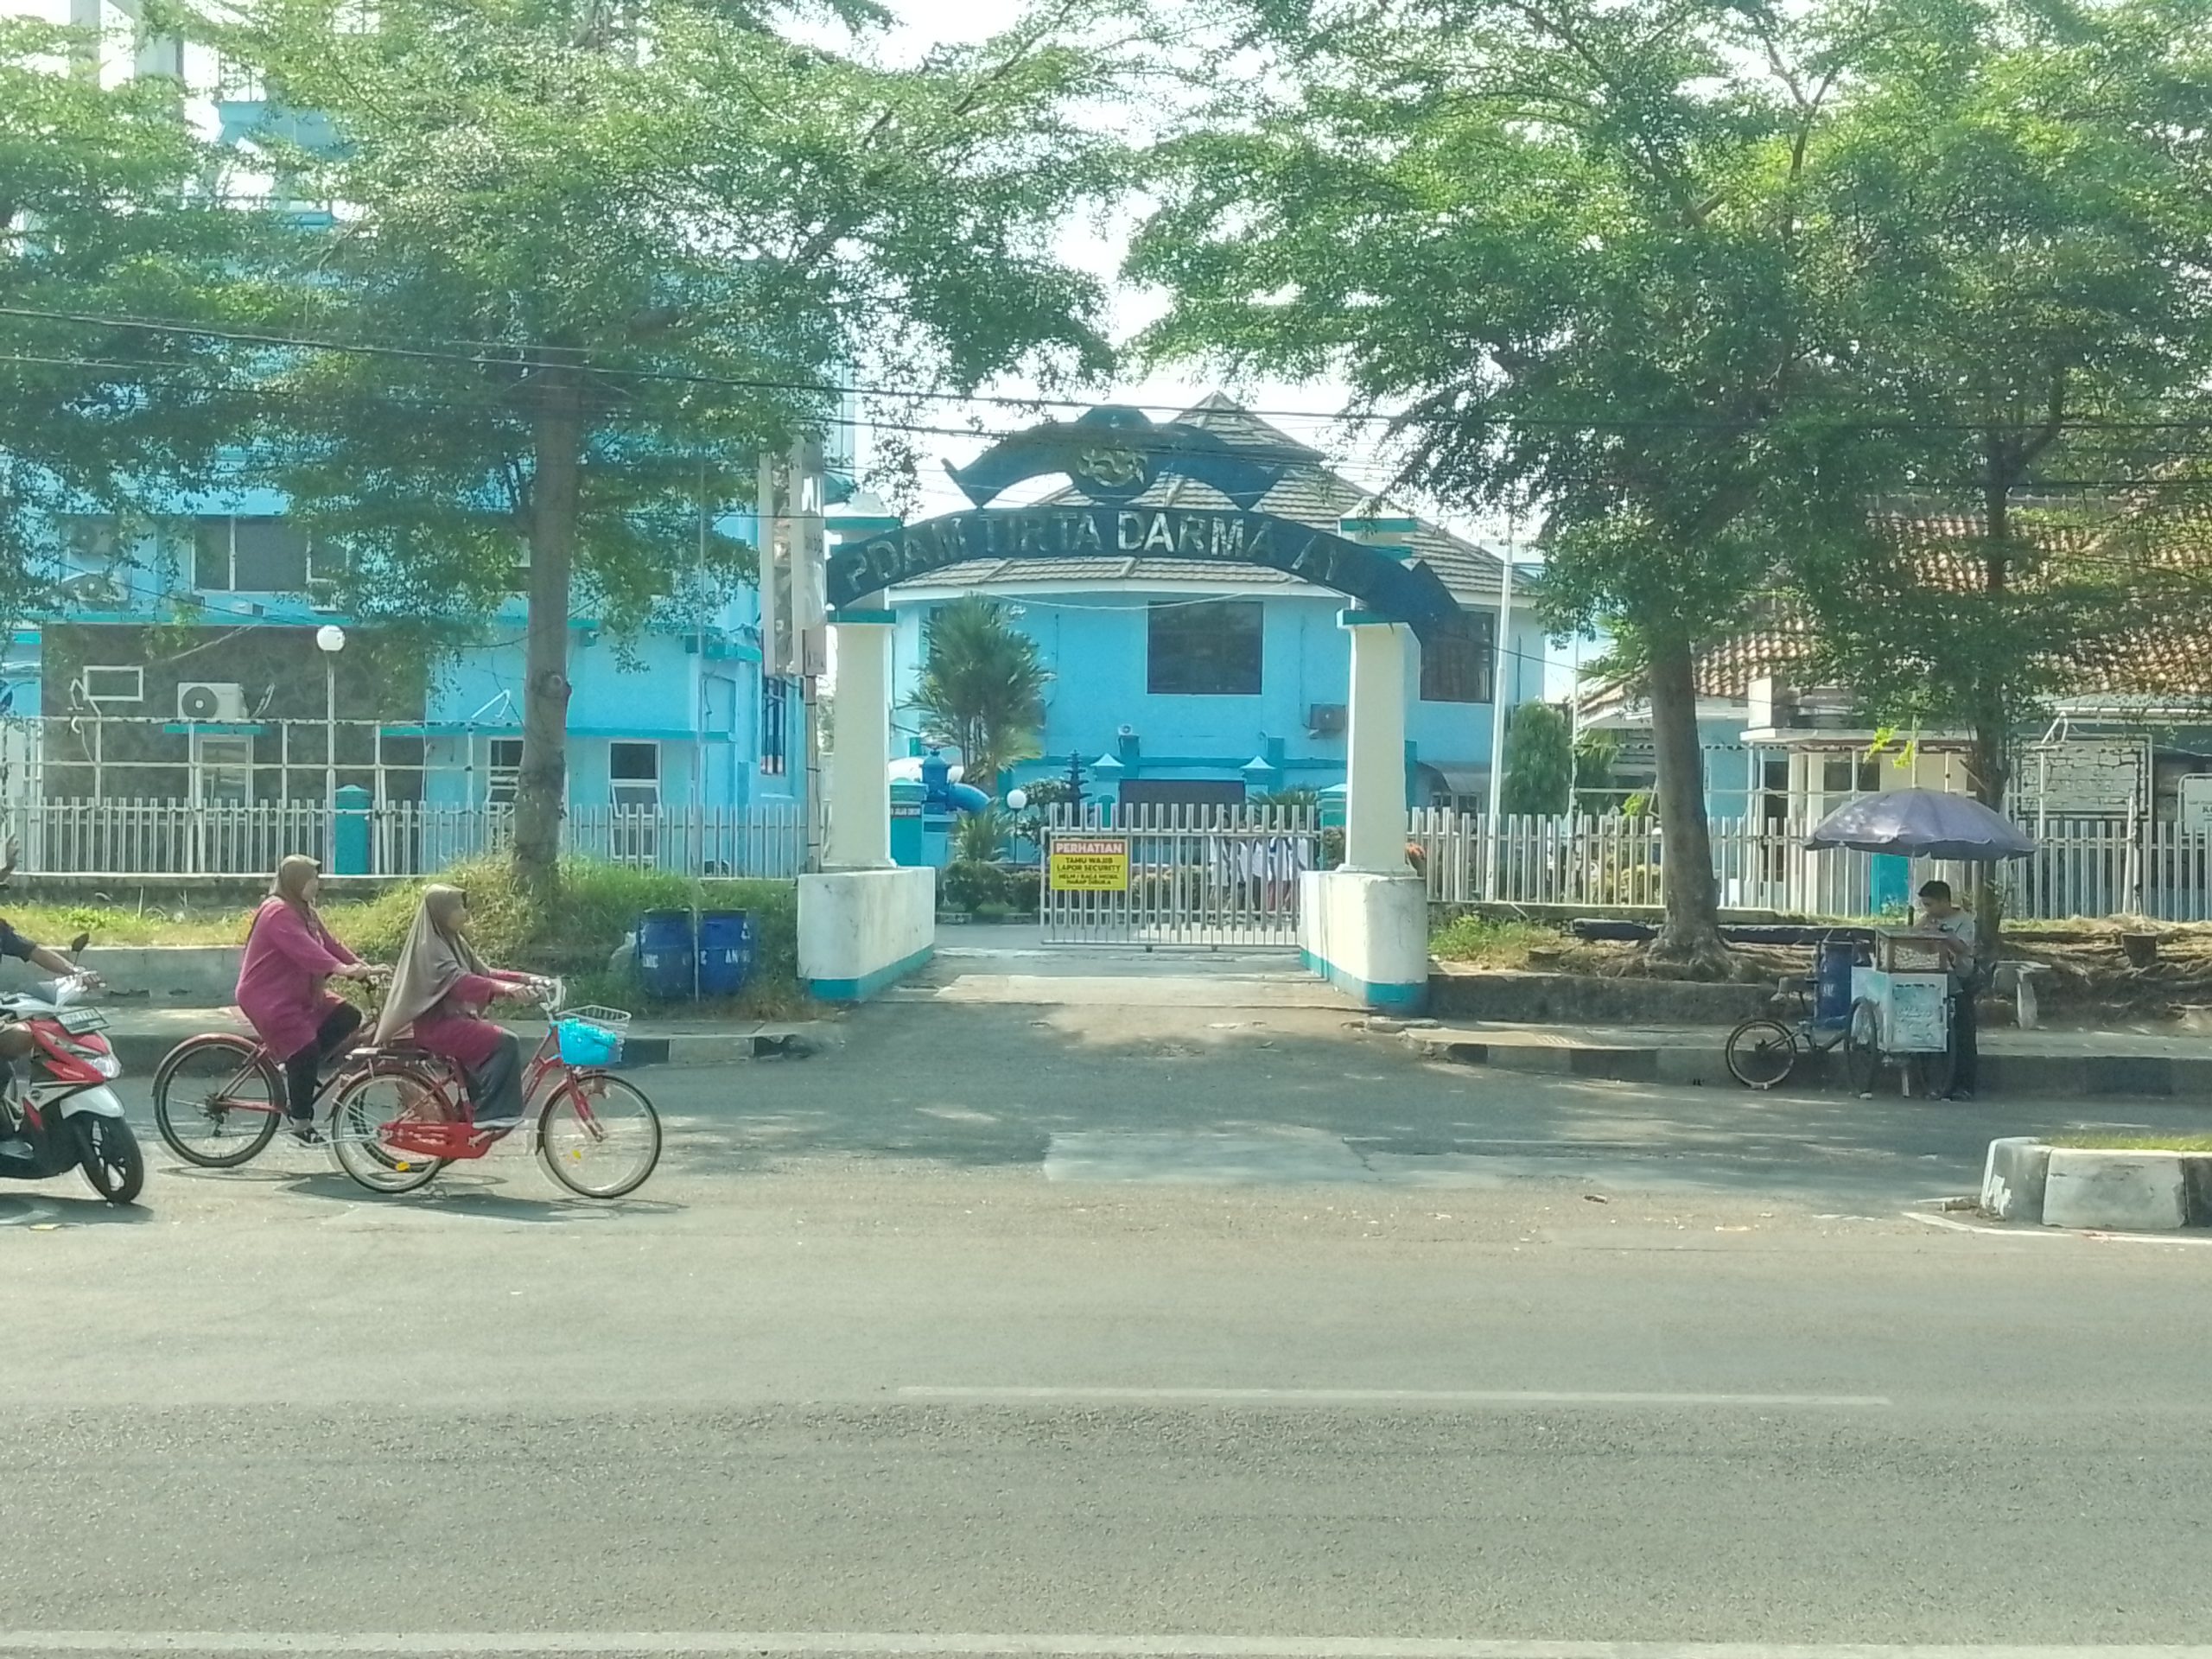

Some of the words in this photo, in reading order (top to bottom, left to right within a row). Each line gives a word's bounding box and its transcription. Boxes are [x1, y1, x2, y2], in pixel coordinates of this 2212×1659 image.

[845, 518, 967, 594] PDAM
[978, 511, 1103, 553] TIRTA
[1116, 510, 1275, 560] DARMA
[1055, 842, 1123, 854] PERHATIAN
